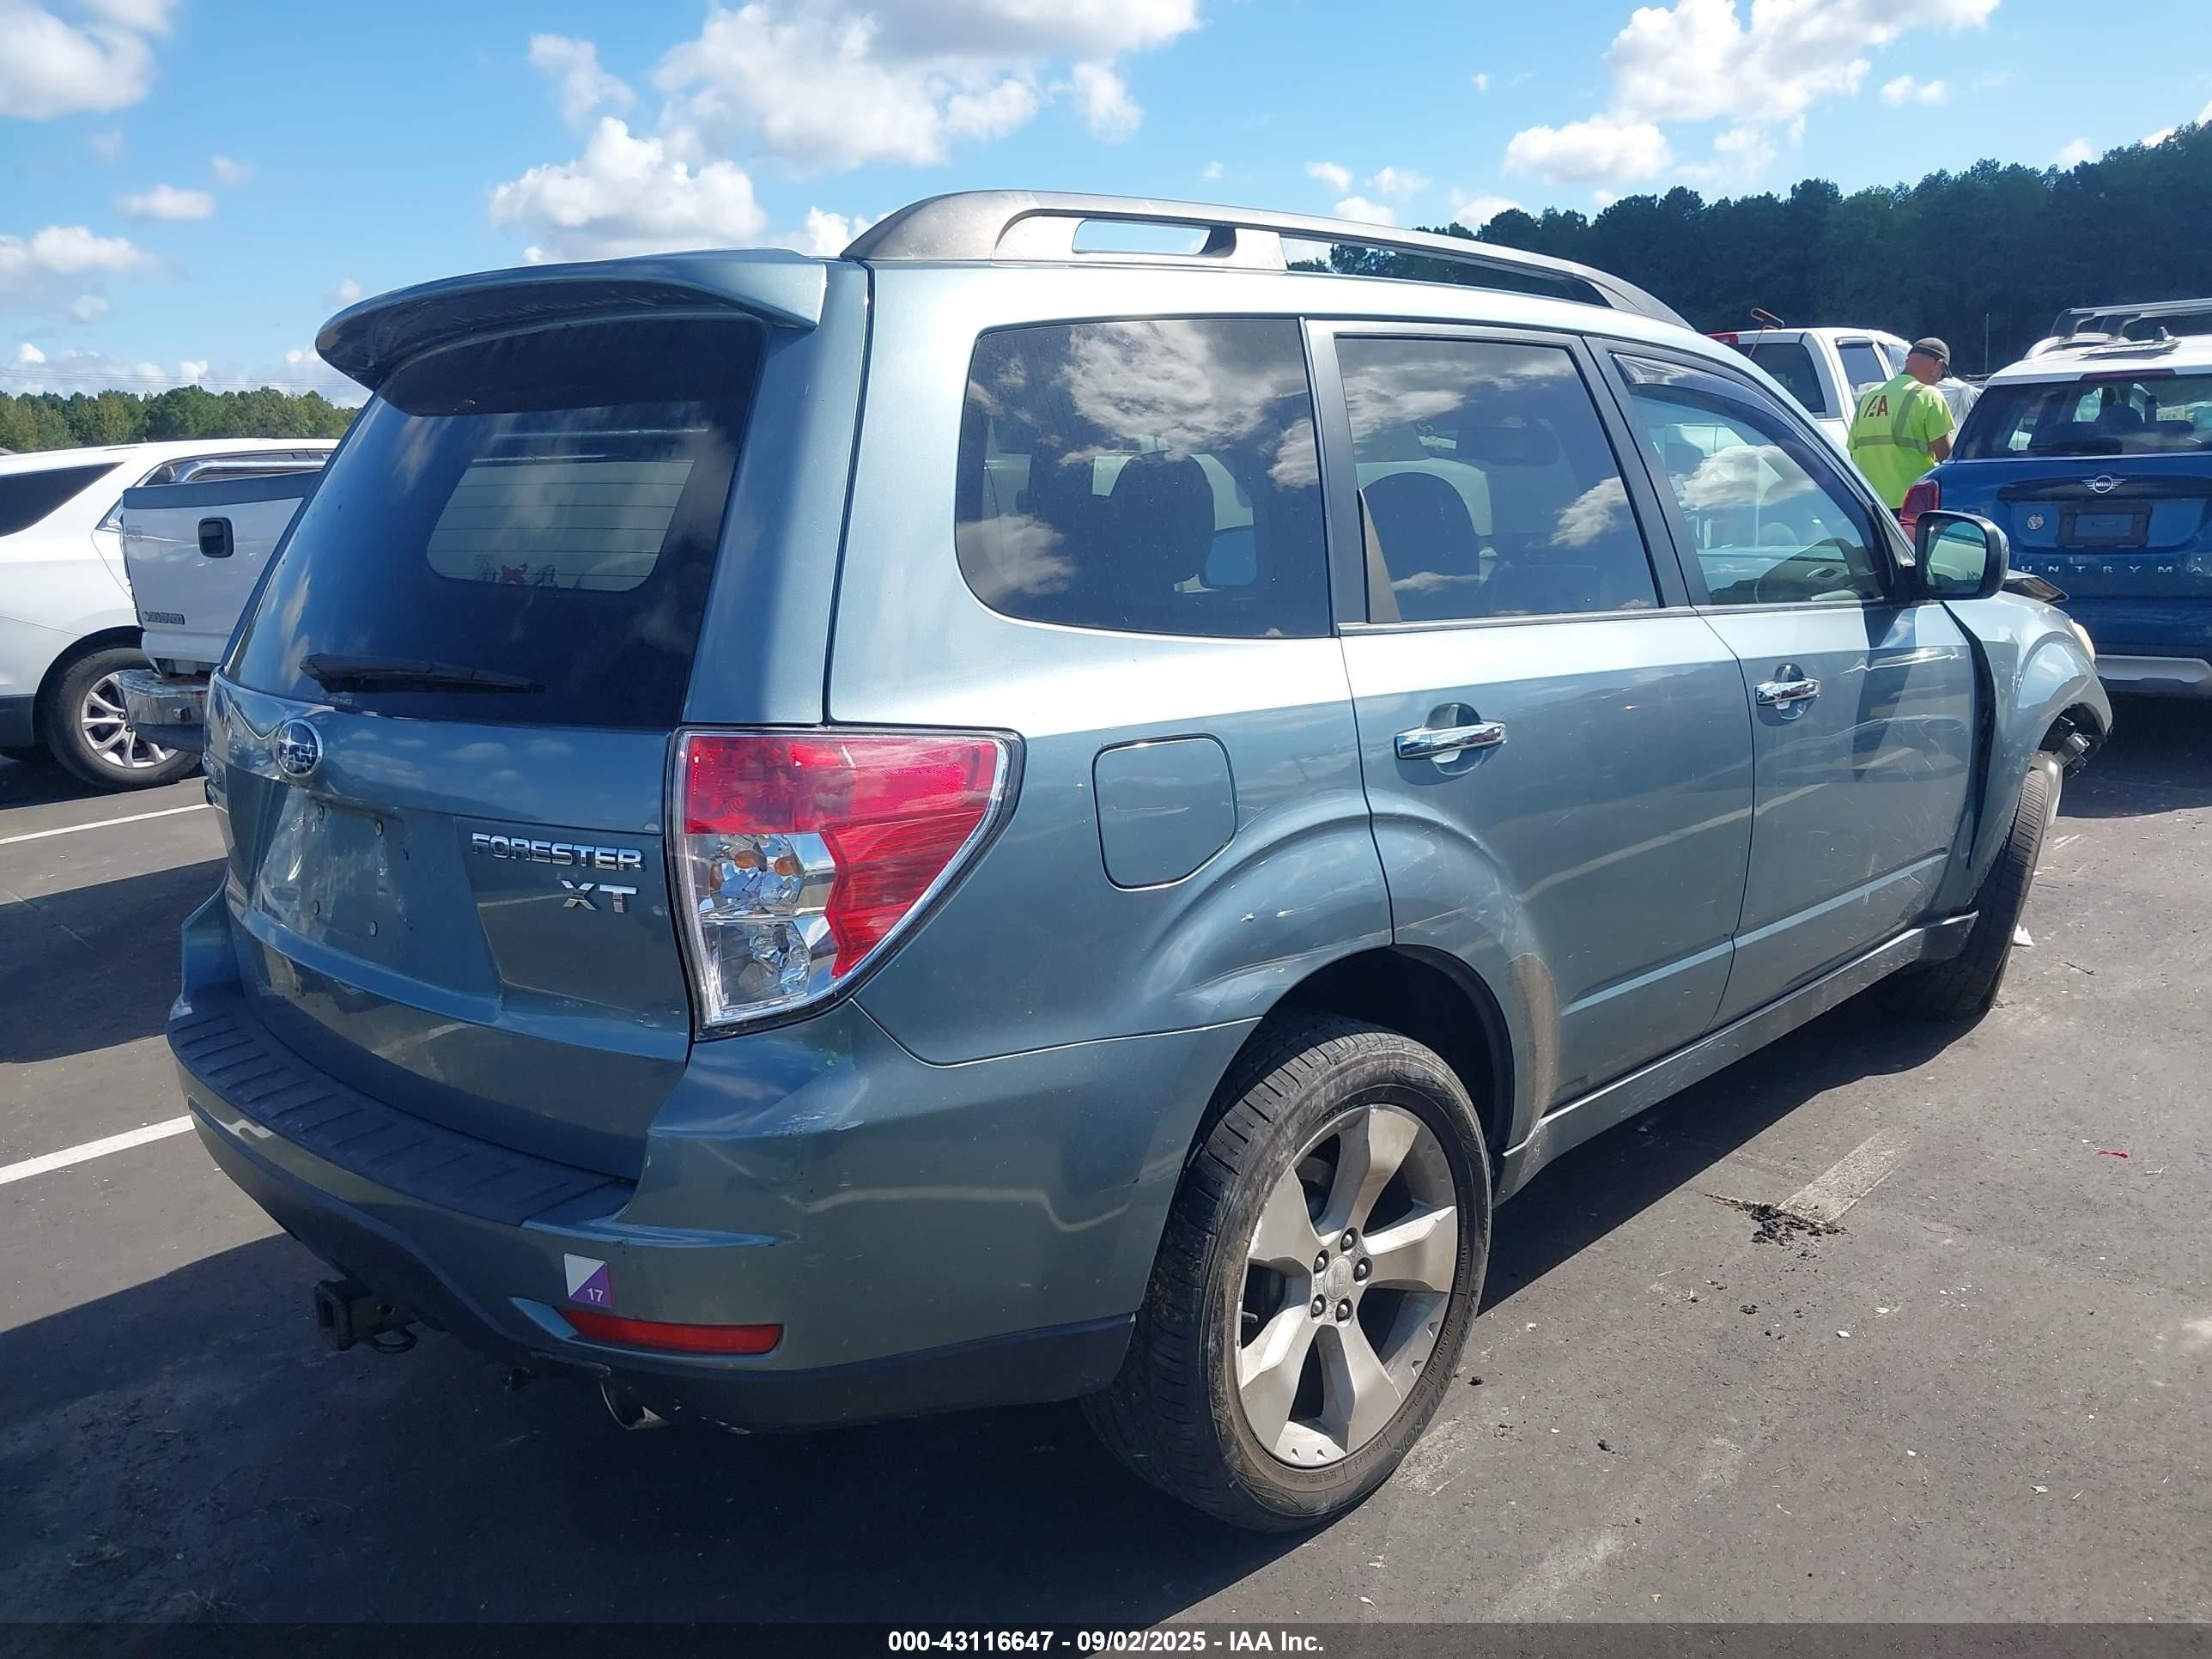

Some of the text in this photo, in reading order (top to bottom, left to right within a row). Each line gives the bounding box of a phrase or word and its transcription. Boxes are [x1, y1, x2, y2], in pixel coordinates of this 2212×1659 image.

[471, 832, 645, 872] FORESTER
[561, 879, 638, 914] XT
[586, 1287, 604, 1303] 17
